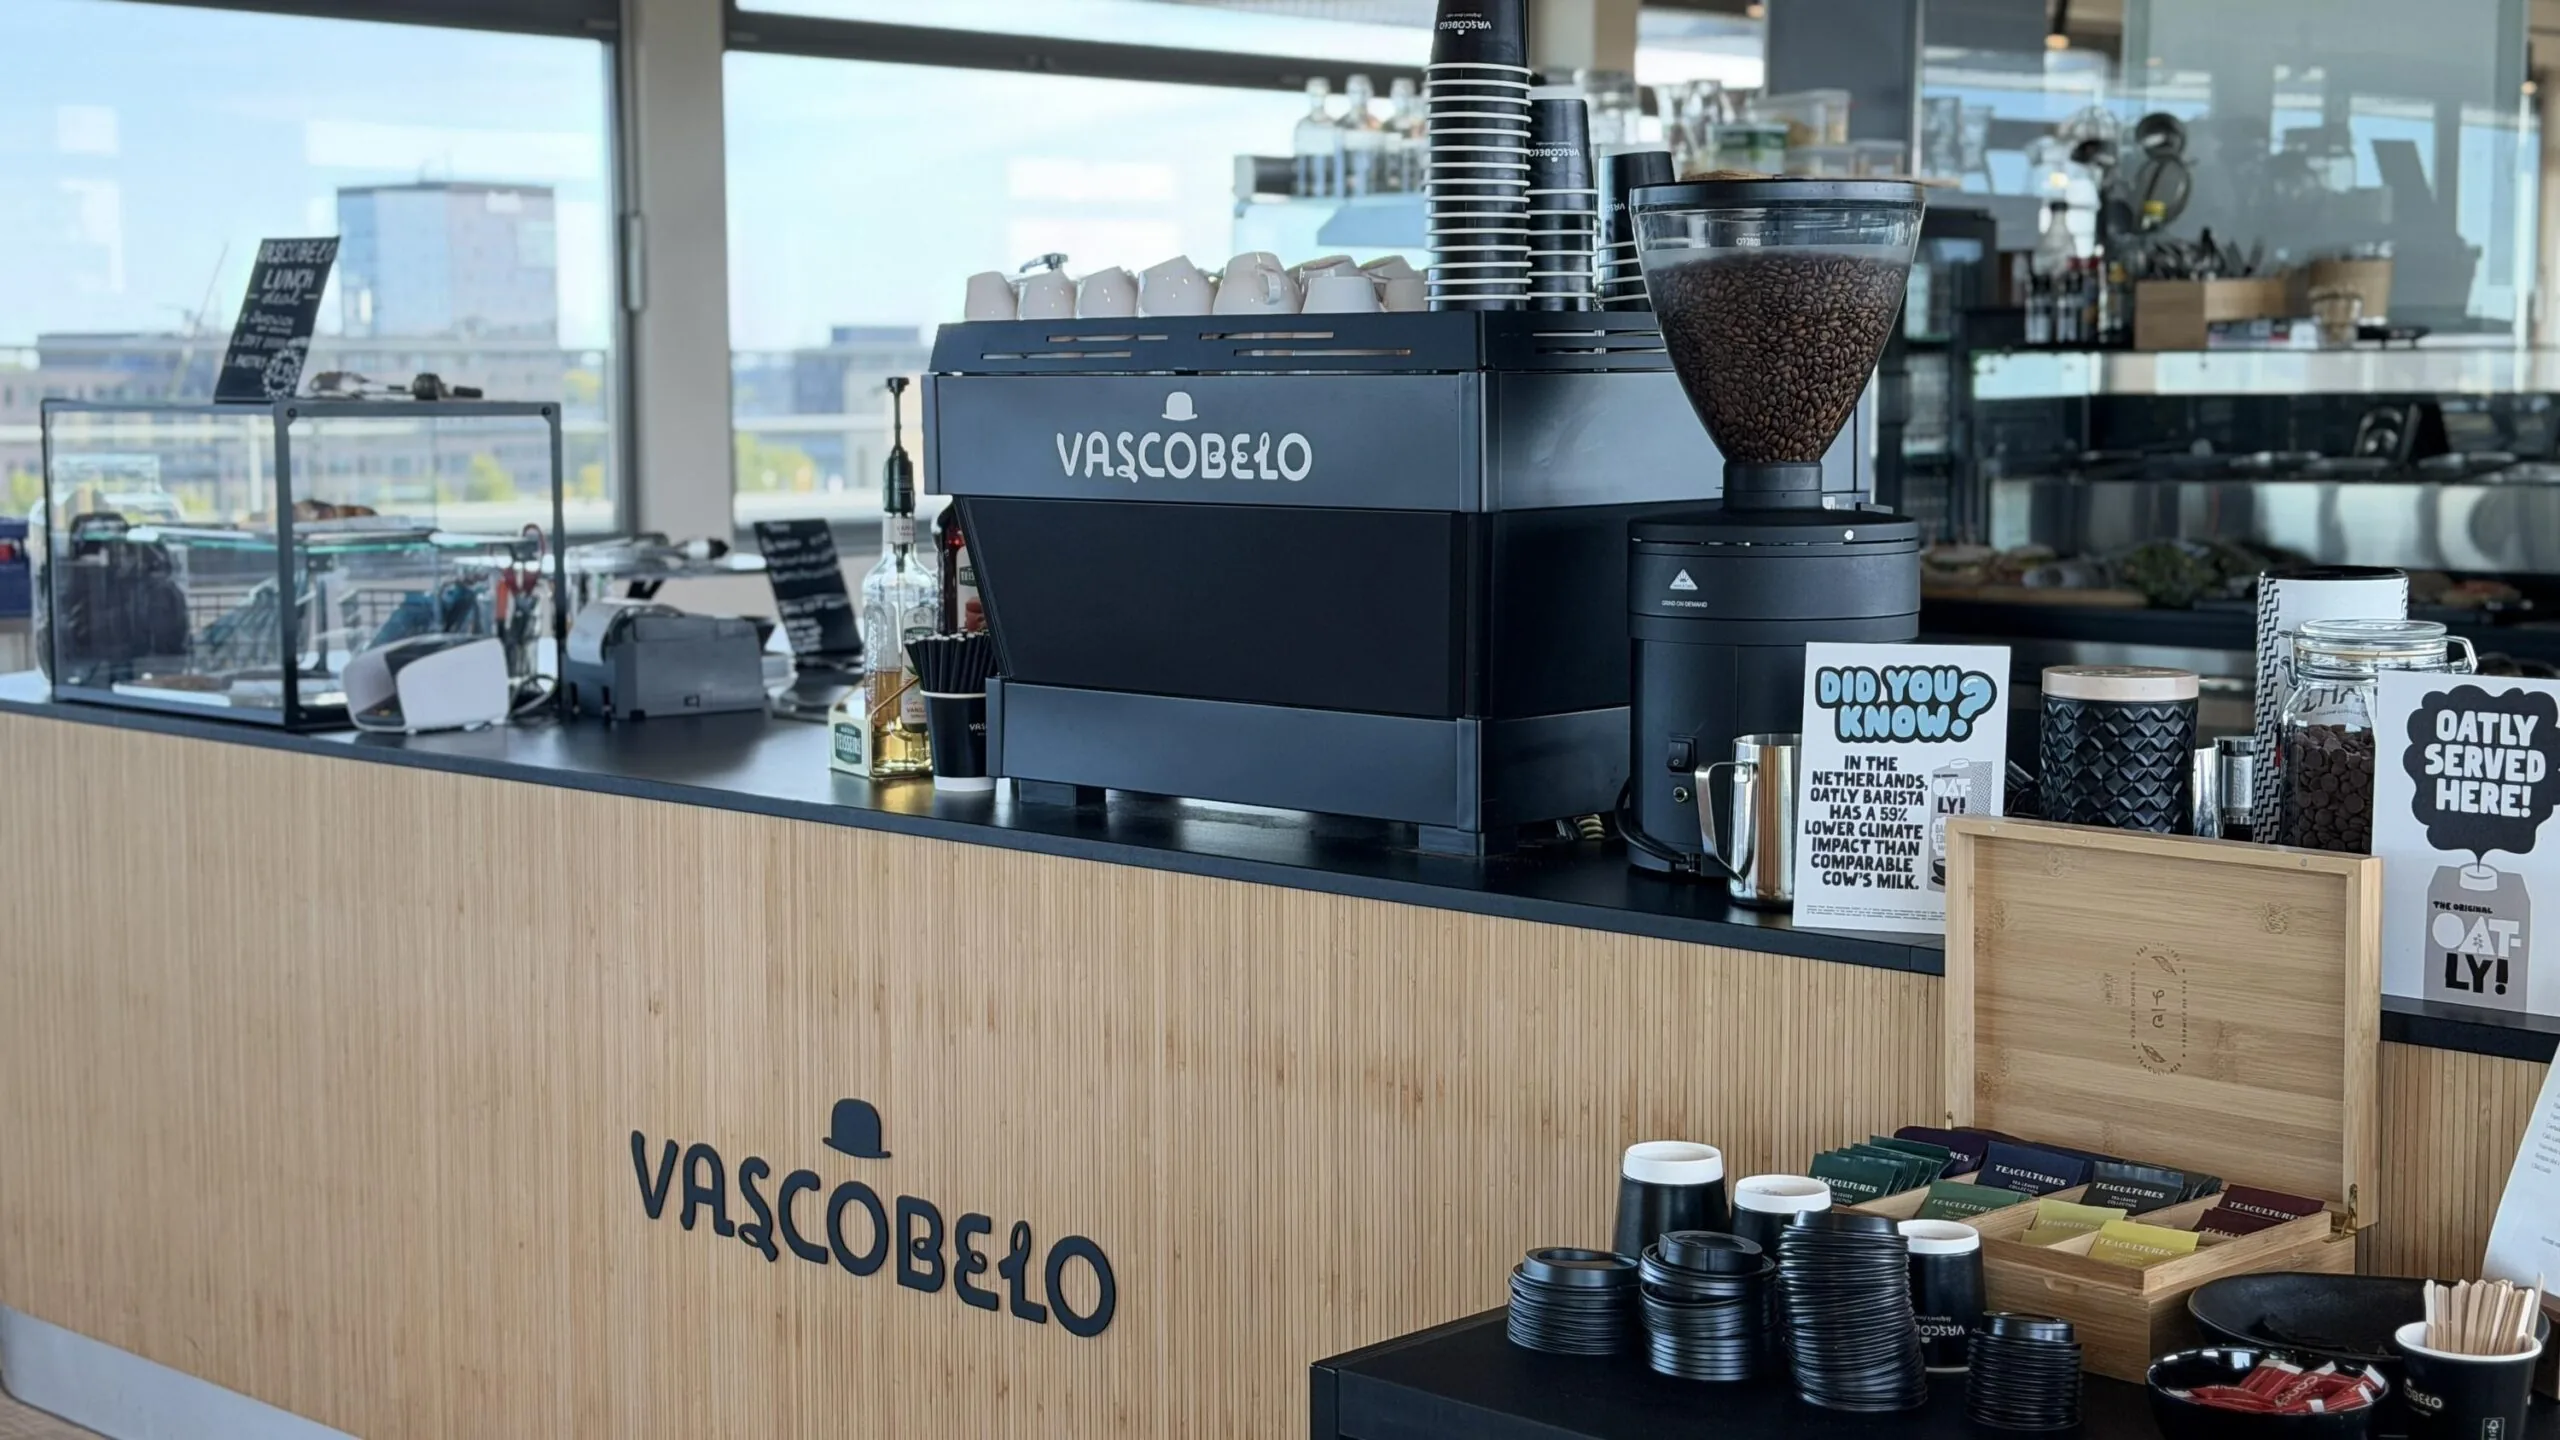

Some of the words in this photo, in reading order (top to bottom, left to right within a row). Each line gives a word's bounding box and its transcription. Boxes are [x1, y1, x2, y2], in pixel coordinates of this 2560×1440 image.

[1439, 20, 1492, 30] VASCOBELO
[1529, 148, 1581, 158] VASCOBELO
[262, 268, 315, 290] LUNCH
[1056, 431, 1313, 483] VASCOBELO
[1818, 668, 1878, 706] DID
[1883, 667, 1960, 704] YOU
[2435, 709, 2539, 747] OATLY
[1844, 755, 1863, 771] IN
[1865, 756, 1898, 772] THE
[2424, 743, 2547, 783] SERVED
[1812, 771, 1929, 792] NETHERLANDS,
[1810, 788, 1860, 804] OATLY
[1863, 789, 1925, 806] BARISTA
[1937, 796, 1966, 814] LY!
[2435, 778, 2532, 819] HERE!
[1829, 805, 1862, 821] HAS
[1865, 807, 1876, 821] A
[1880, 807, 1908, 823] 59%
[1804, 819, 1855, 837] LOWER
[1859, 823, 1924, 840] CLIMATE
[1811, 836, 1874, 854] IMPACT
[1876, 840, 1920, 857] THAN
[1810, 853, 1913, 873] COMPARABLE
[1876, 873, 1920, 890] MILK.
[2433, 900, 2451, 911] THE
[2453, 903, 2494, 914] ORIGINAL
[2445, 952, 2509, 996] LY!
[1816, 1175, 1878, 1193] TEACULTURES
[1995, 1164, 2068, 1186] TEACULTURES
[2095, 1182, 2165, 1199] TEACULTURES
[1932, 1199, 1991, 1213] TEACULTUR
[2229, 1200, 2297, 1220] TEACULTURE
[630, 1130, 1117, 1338] VASCOBELO
[1914, 1325, 1966, 1336] VASCO
